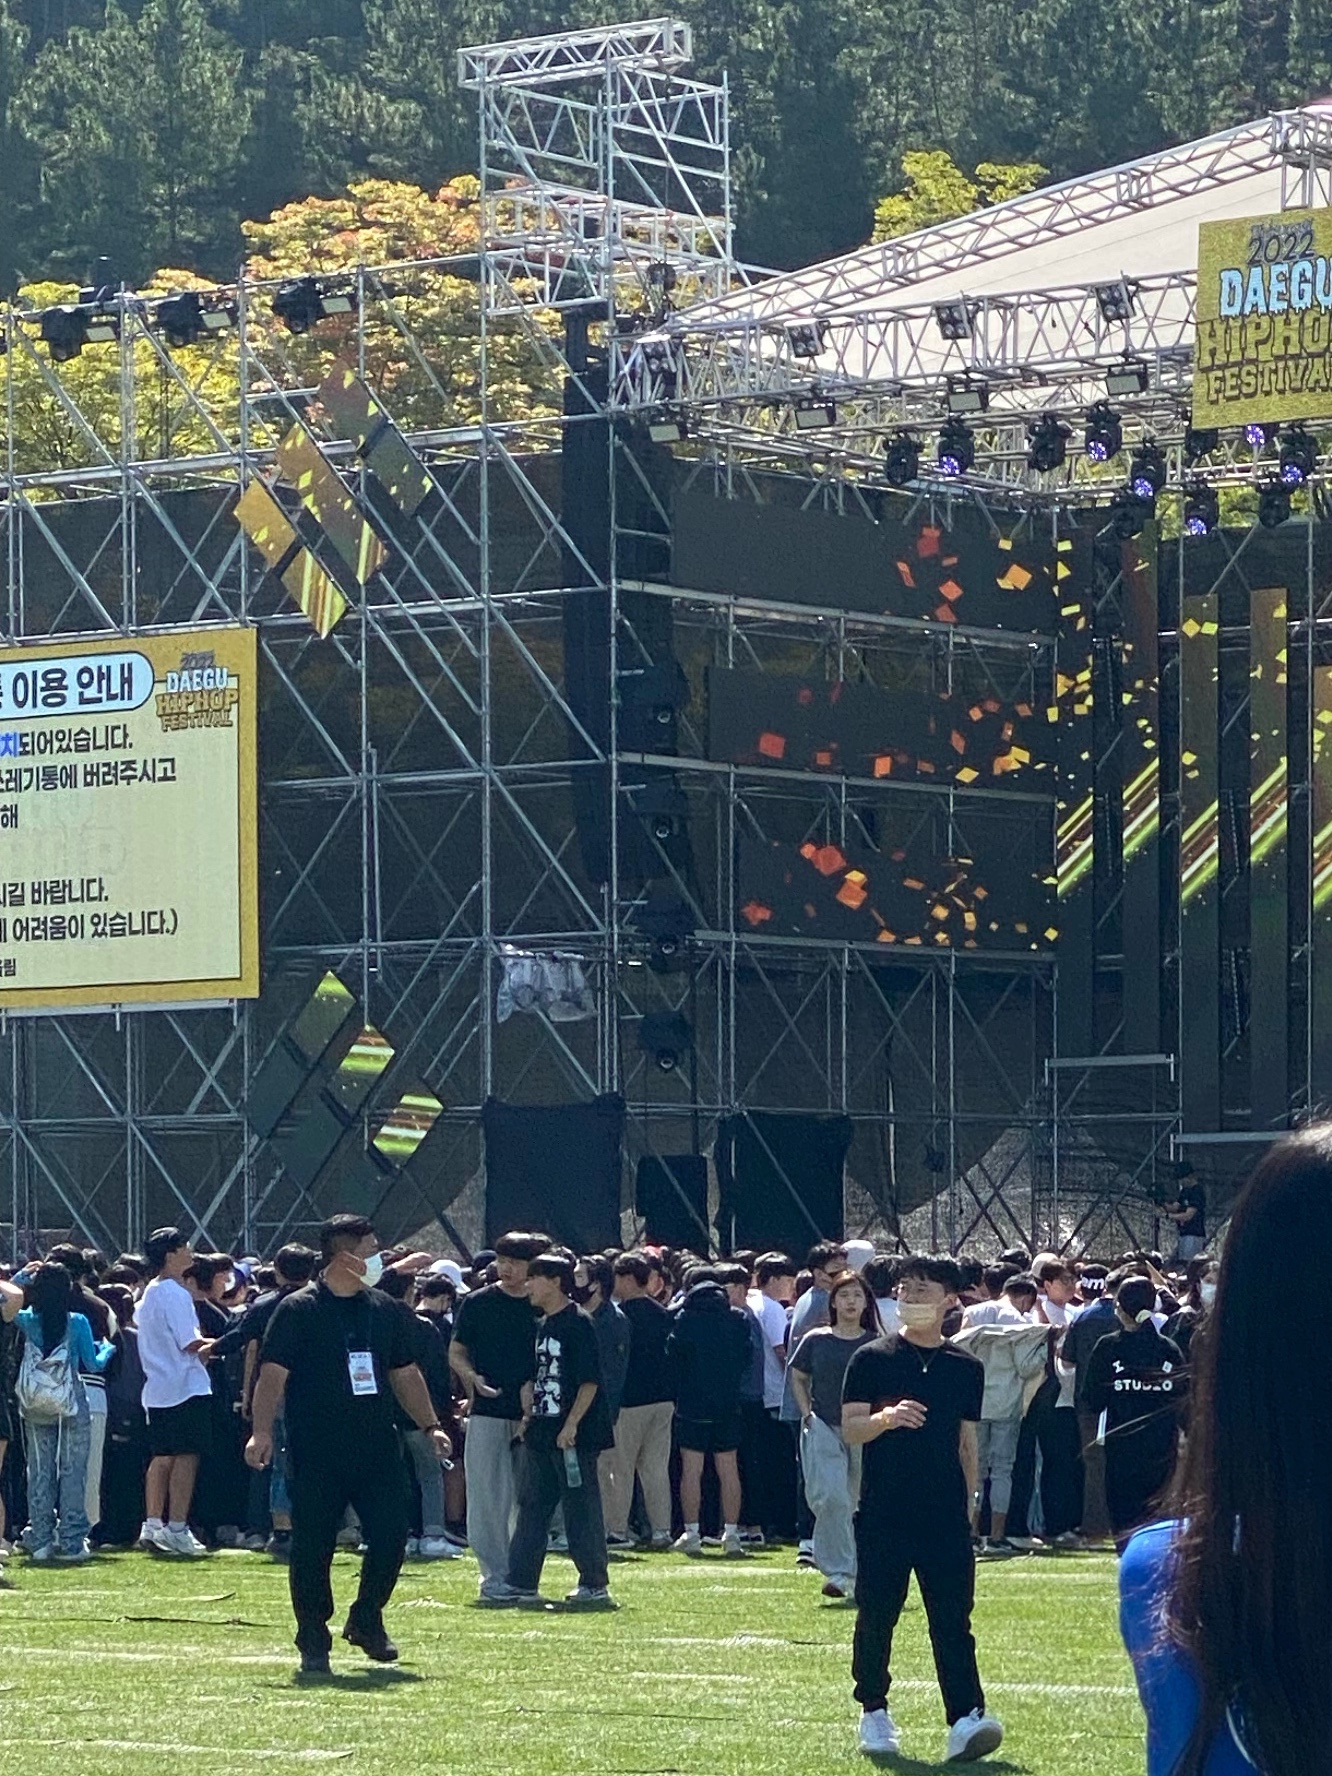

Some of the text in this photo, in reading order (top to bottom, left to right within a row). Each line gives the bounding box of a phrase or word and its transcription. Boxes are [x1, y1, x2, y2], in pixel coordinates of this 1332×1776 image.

[1247, 230, 1315, 264] 2022
[12, 667, 68, 709] 이용
[76, 662, 133, 705] 안내
[166, 667, 228, 692] DAEGU
[155, 690, 238, 717] HIPHOP
[161, 711, 233, 732] FESTIVAL
[83, 757, 177, 788] 버려주시고
[31, 877, 109, 906] 바랍니다.
[13, 914, 84, 942] 어려움이
[90, 908, 178, 938] 있습니다.)
